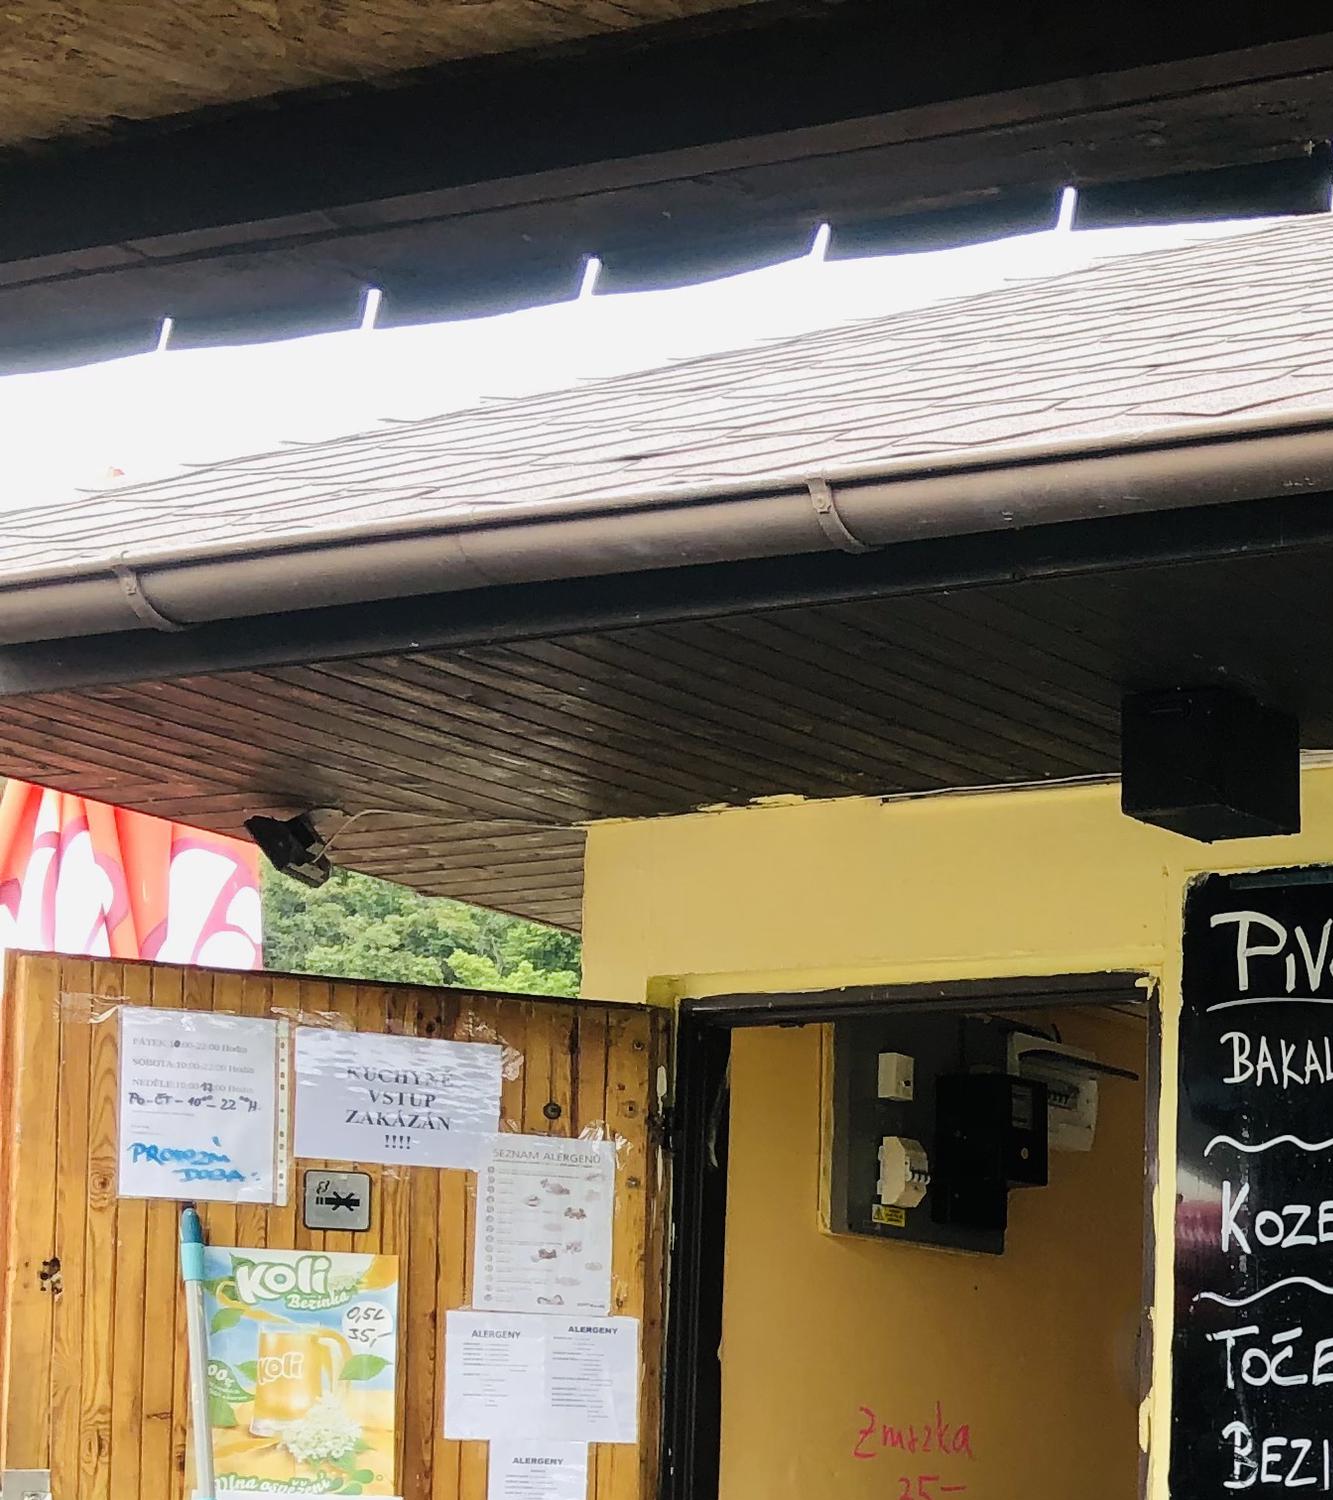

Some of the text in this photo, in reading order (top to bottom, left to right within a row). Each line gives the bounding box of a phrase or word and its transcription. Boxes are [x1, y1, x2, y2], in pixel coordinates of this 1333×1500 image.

[369, 1089, 436, 1108] VSTUP
[345, 1109, 450, 1131] ZAKÁZÁN
[494, 1149, 540, 1160] SEZNAM
[236, 1256, 331, 1304] Koli
[471, 1326, 618, 1339] ALERGENY ALERGENY
[512, 1457, 564, 1465] ALERGENY
